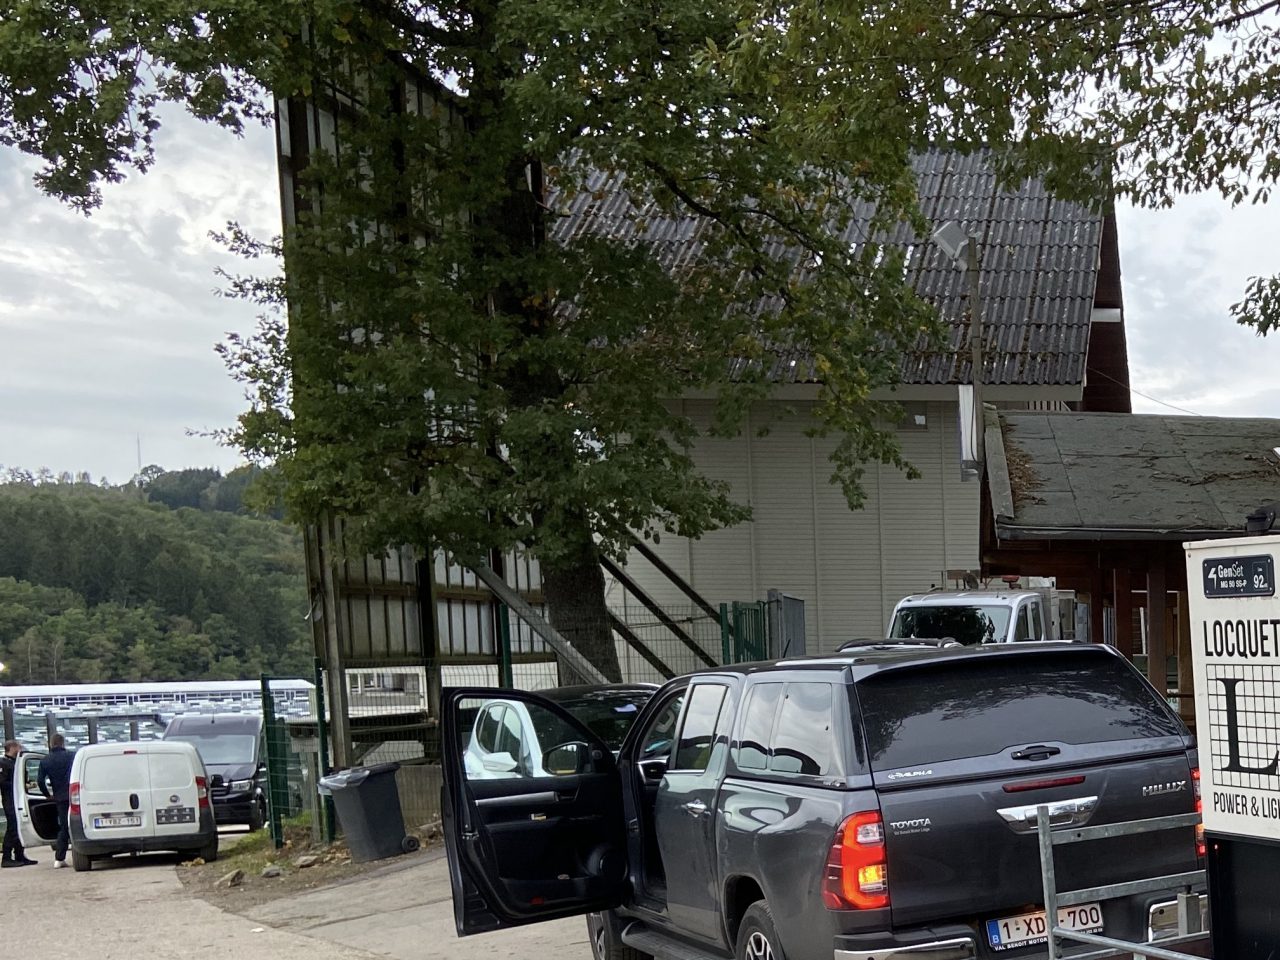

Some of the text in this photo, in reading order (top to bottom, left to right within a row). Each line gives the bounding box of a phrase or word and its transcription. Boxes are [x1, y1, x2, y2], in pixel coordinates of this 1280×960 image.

[1217, 563, 1244, 578] GenSet
[1253, 574, 1264, 588] 92
[1203, 619, 1280, 659] LOCQUET
[1142, 780, 1186, 797] HILUX
[1213, 791, 1249, 816] POWER
[1250, 797, 1260, 818] &
[890, 817, 931, 829] TOYOTA
[1003, 906, 1100, 940] 1-XD-700
[992, 935, 1000, 944] B
